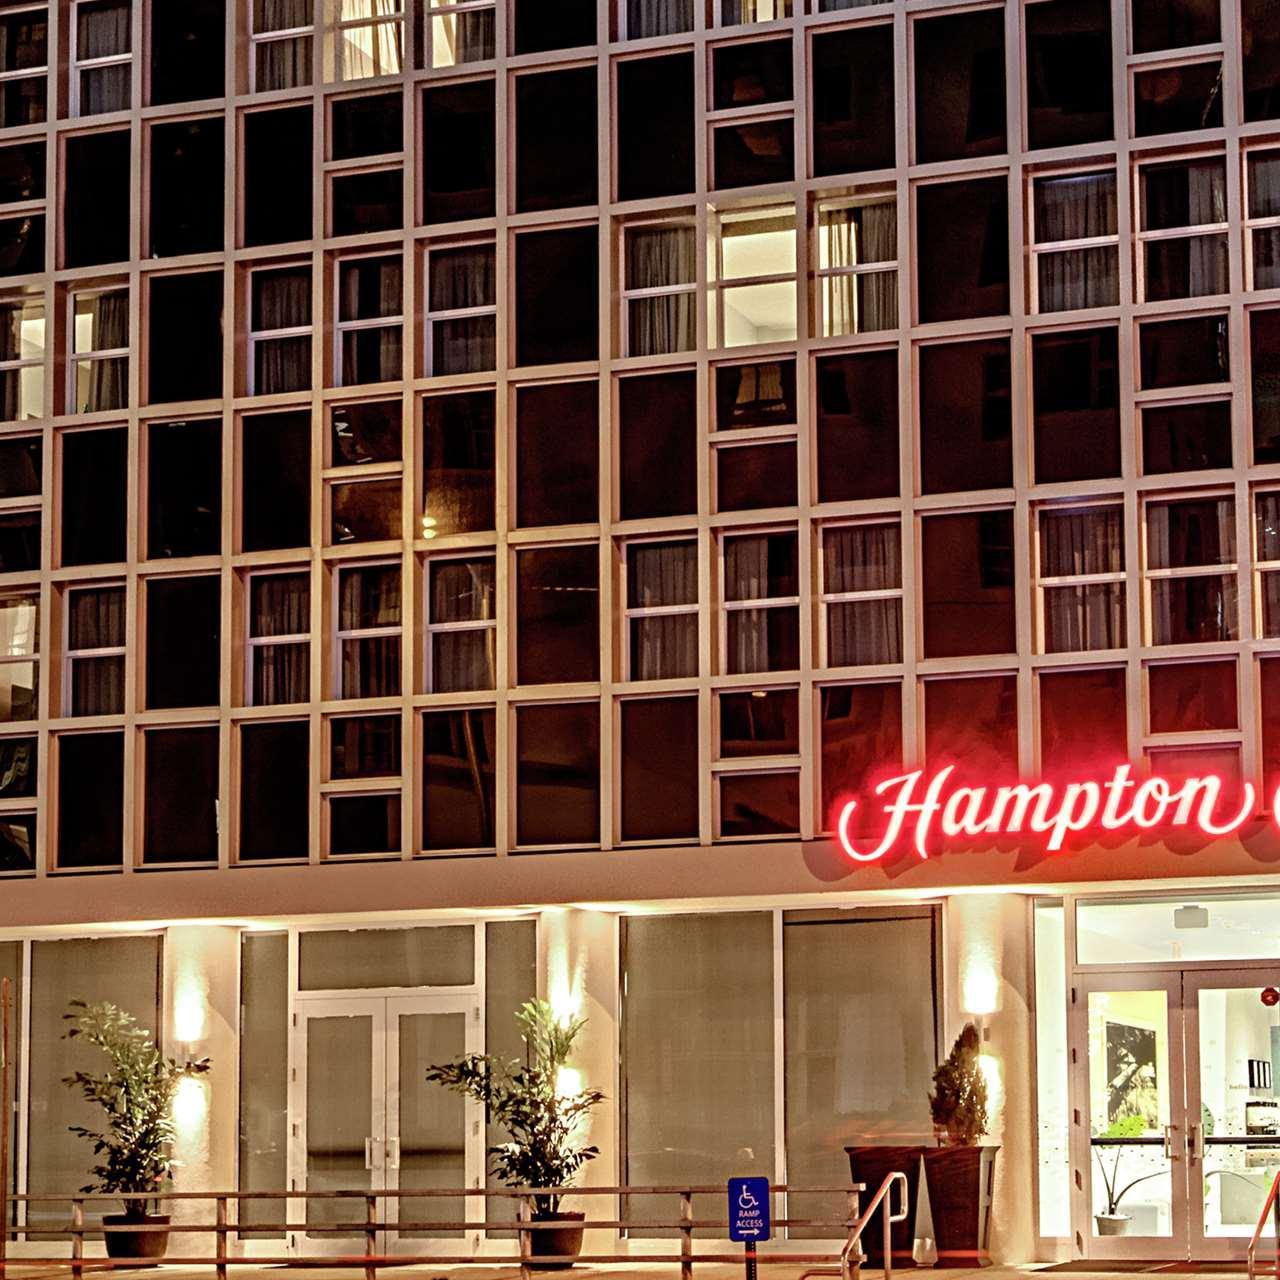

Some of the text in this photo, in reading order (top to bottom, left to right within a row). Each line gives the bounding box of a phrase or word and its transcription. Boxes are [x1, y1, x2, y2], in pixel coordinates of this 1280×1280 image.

[837, 762, 1255, 862] Hampton
[738, 1209, 760, 1218] RAMP
[735, 1218, 764, 1228] ACCESS
